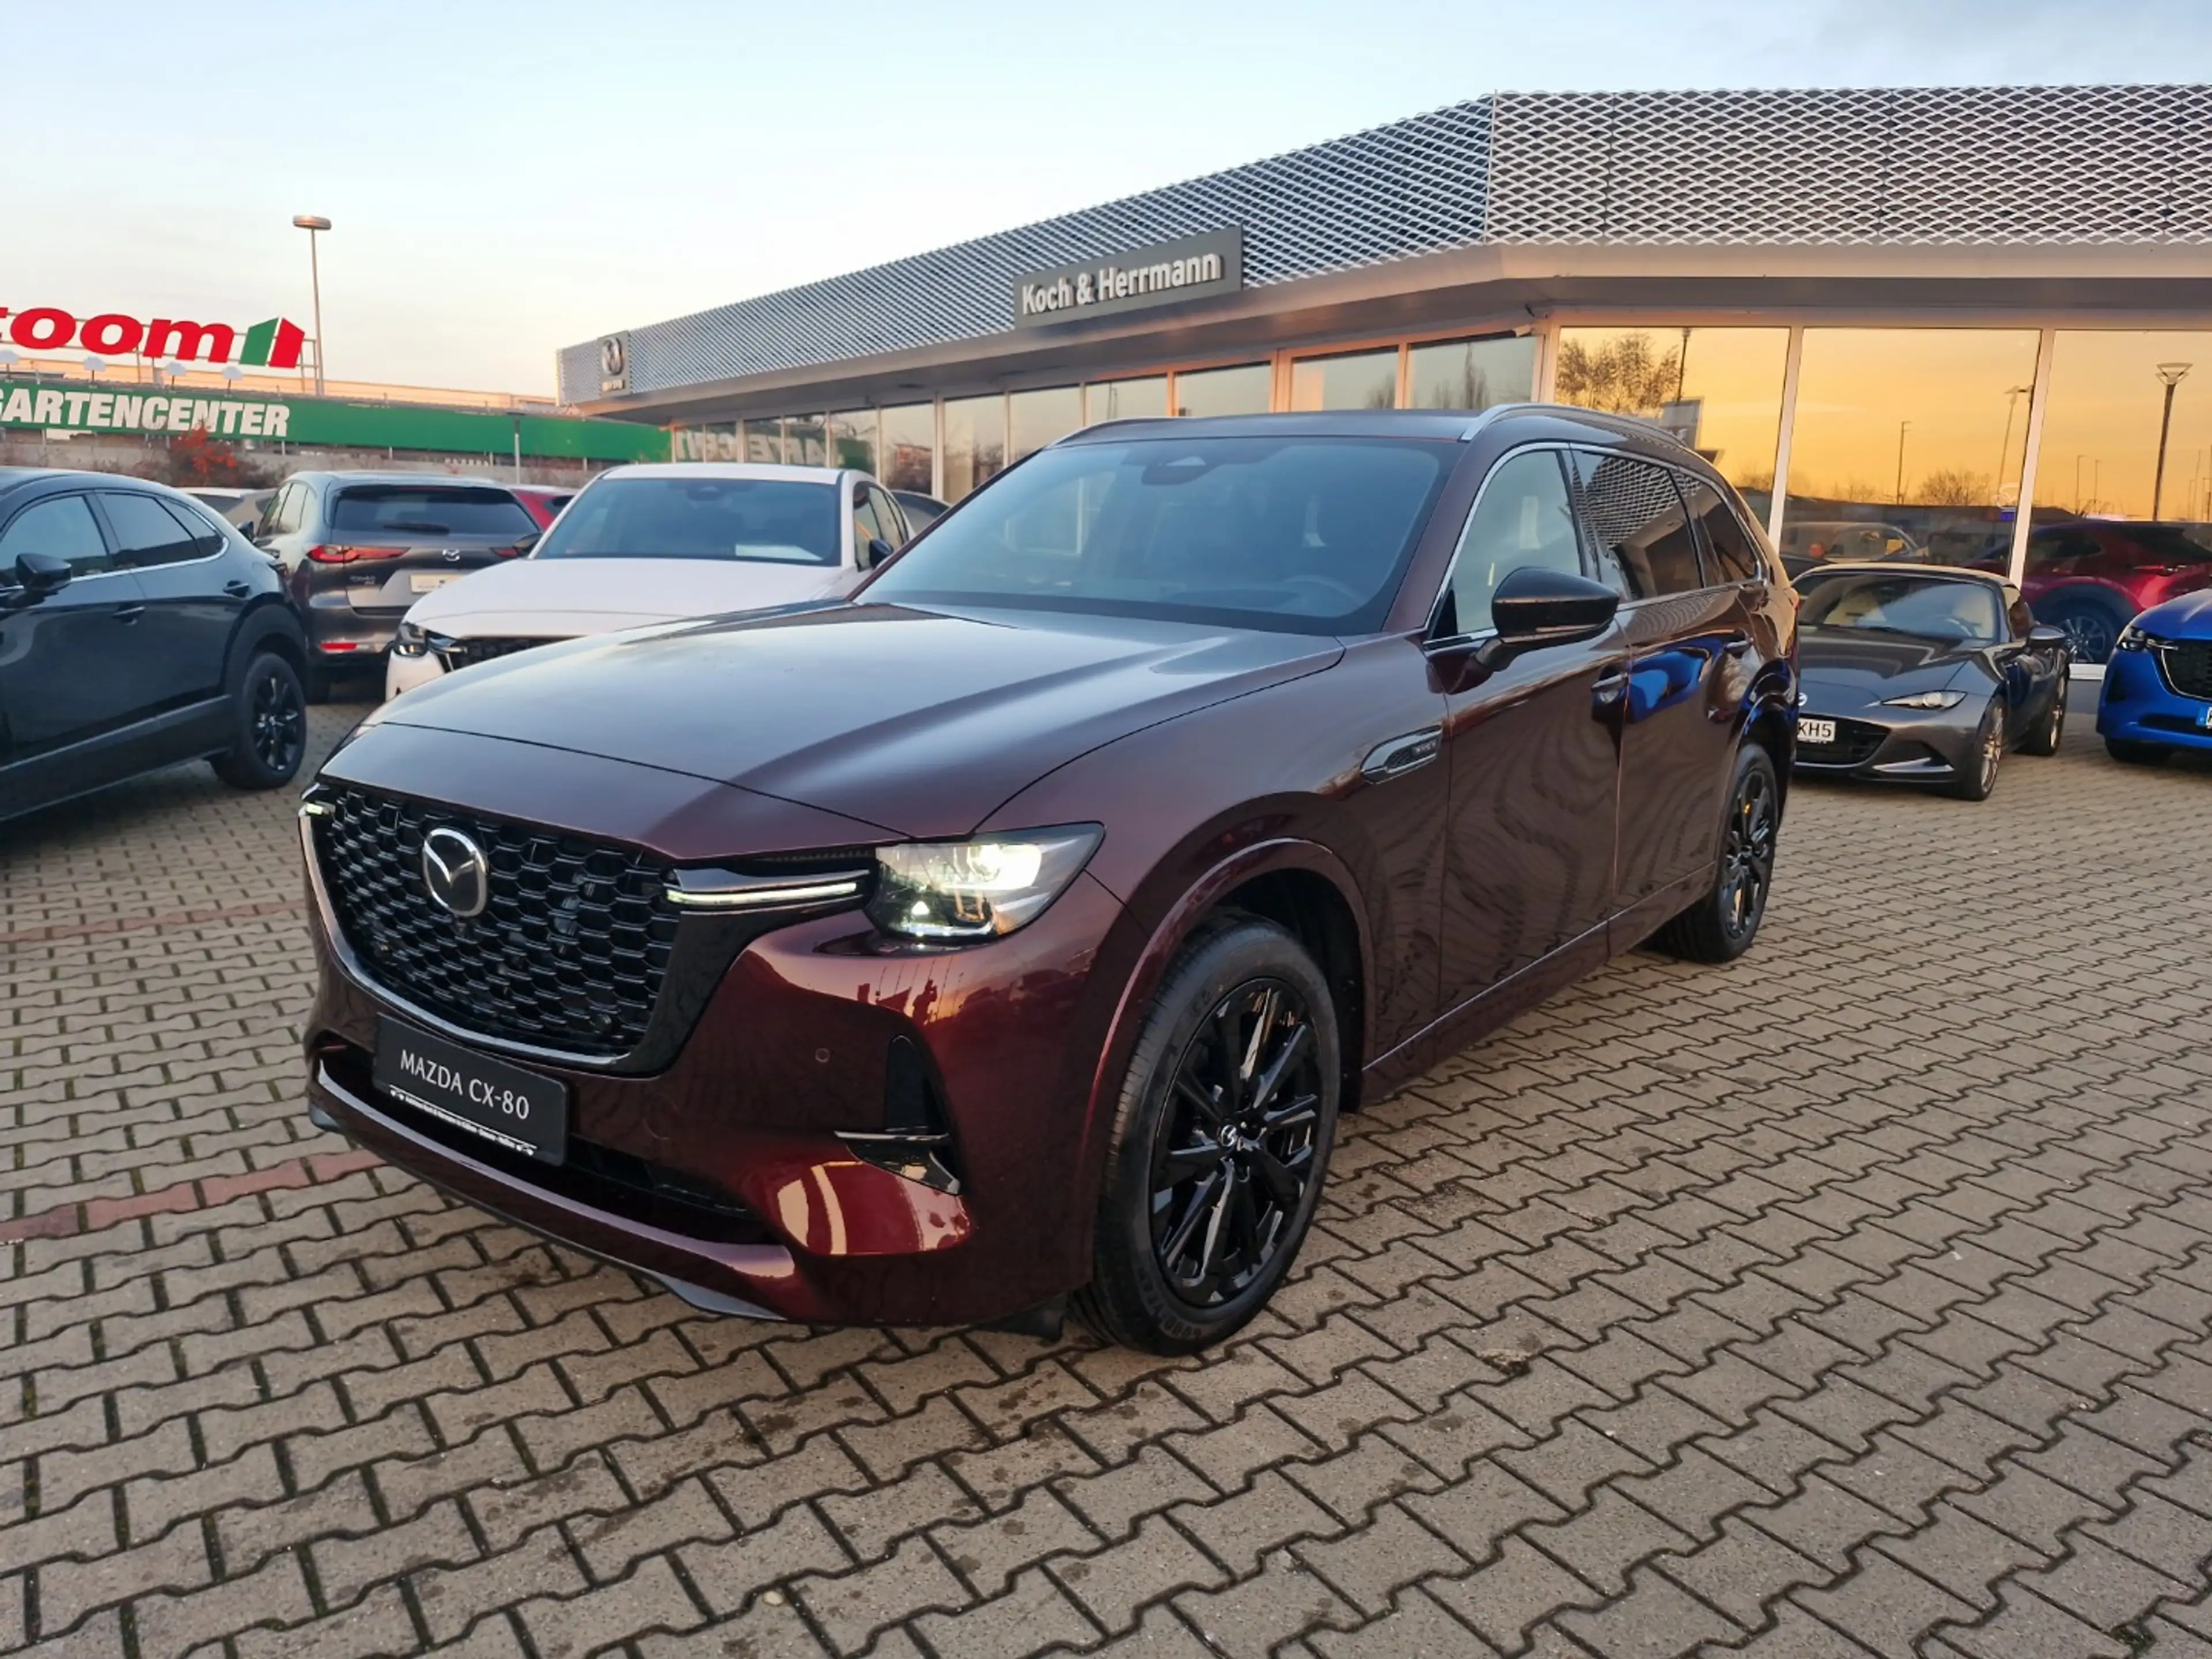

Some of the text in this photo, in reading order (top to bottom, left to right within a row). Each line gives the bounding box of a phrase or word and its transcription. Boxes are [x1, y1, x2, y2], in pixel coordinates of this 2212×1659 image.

[1022, 253, 1221, 315] Koch & Herrmann
[0, 307, 234, 363] oom
[0, 388, 290, 437] ARTENCENTER
[400, 1049, 529, 1119] MAZDA CX-80
